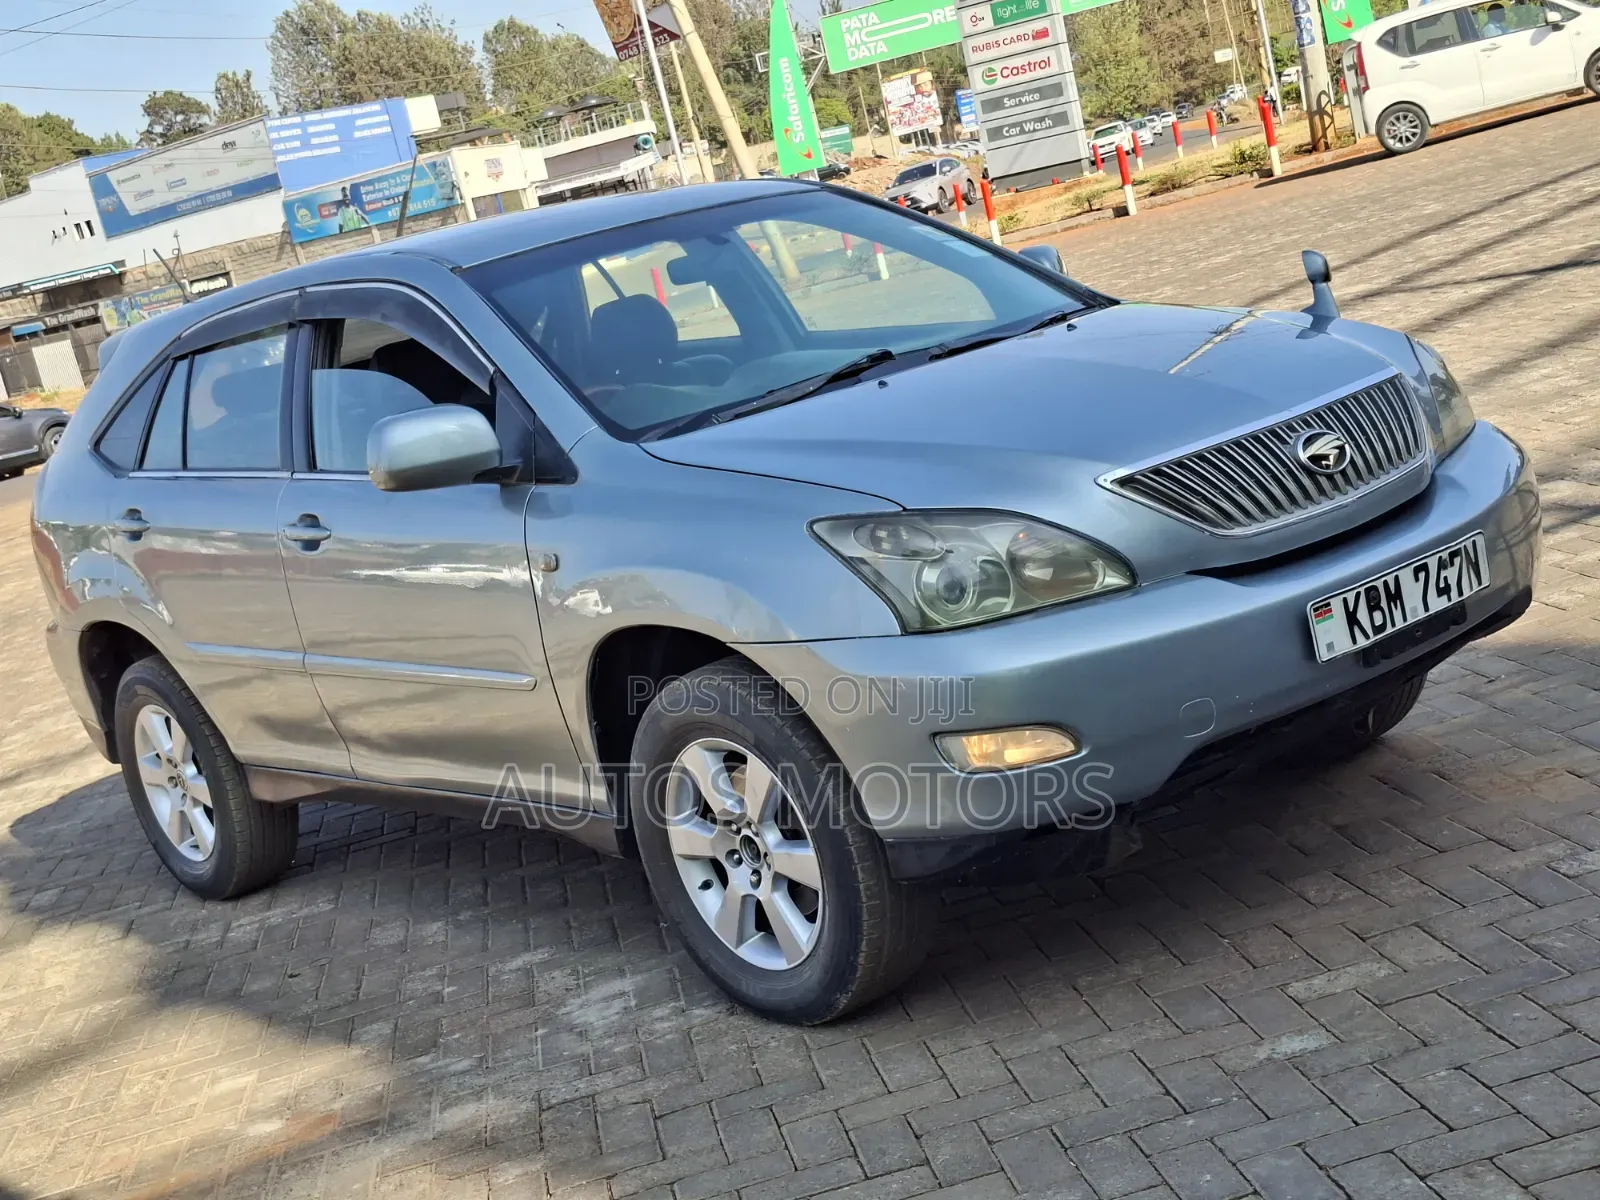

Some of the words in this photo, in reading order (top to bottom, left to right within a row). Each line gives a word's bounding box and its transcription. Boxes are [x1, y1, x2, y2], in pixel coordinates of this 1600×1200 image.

[996, 4, 1018, 18] light
[840, 12, 880, 33] PATA
[618, 46, 639, 61] 0748
[655, 33, 670, 46] 323
[847, 40, 888, 62] DATA
[971, 40, 1001, 54] RUBIS
[1002, 33, 1030, 46] CARD
[1000, 56, 1051, 79] Castrol
[779, 57, 805, 143] Safaricom
[1003, 92, 1040, 108] Service
[1002, 125, 1021, 137] Car
[1022, 117, 1053, 132] Wash
[150, 287, 184, 302] GrandWas
[45, 317, 58, 327] The
[1342, 573, 1407, 645] KBM
[1412, 539, 1483, 613] 747N
